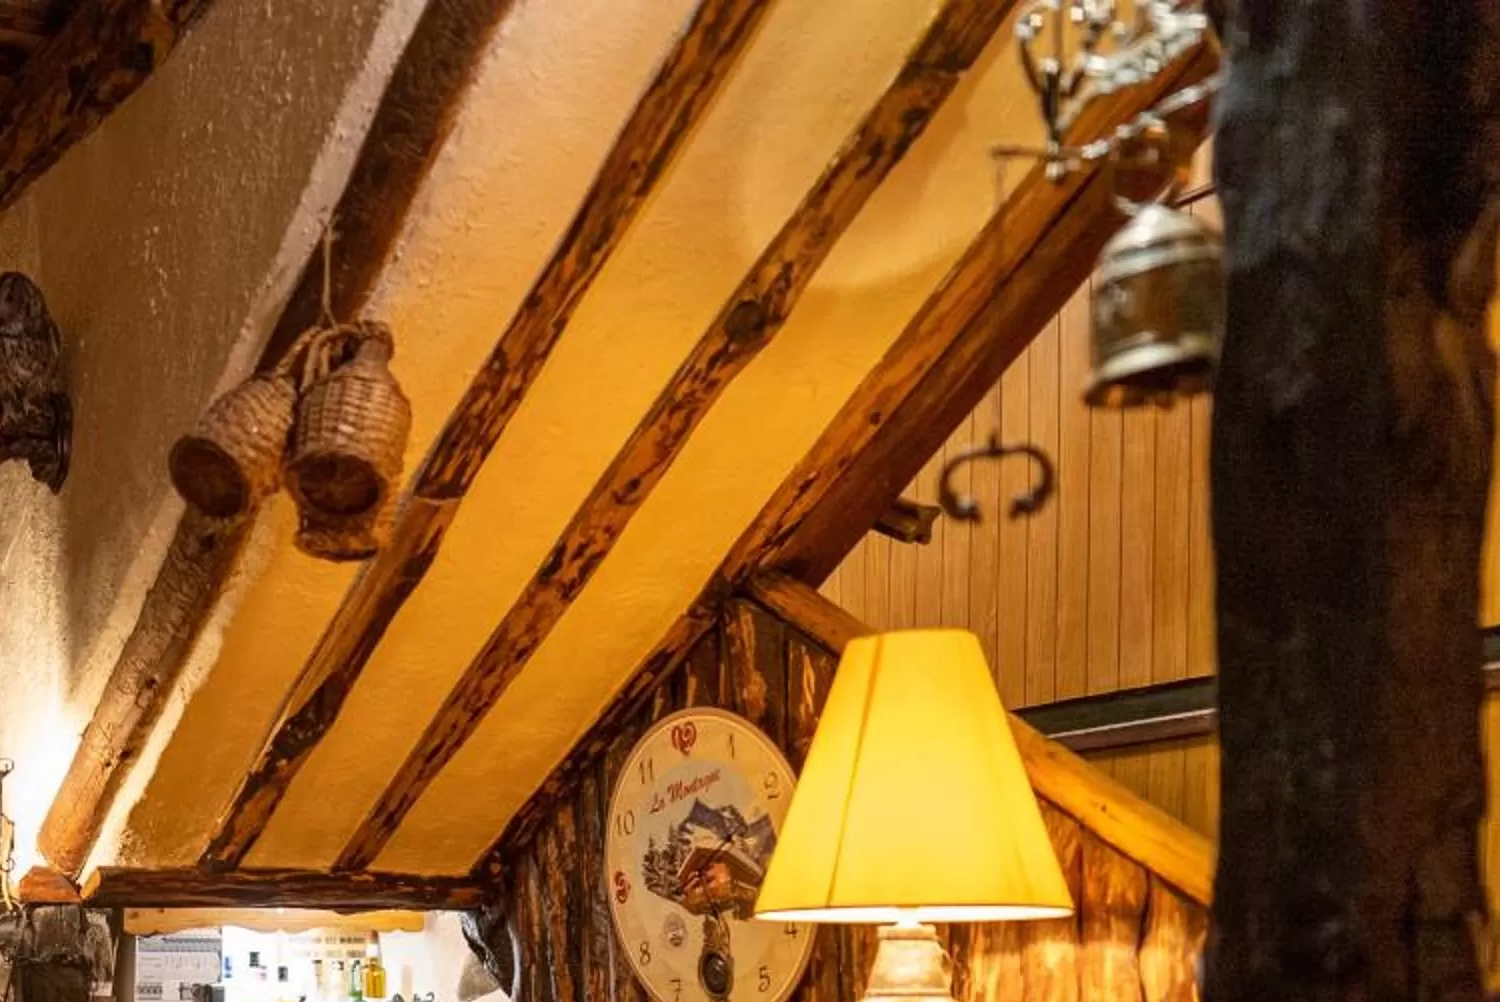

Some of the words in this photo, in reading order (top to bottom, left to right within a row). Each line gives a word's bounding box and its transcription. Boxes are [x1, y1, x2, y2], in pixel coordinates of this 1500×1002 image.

[728, 732, 736, 761] 1
[638, 757, 655, 785] 11
[763, 770, 781, 800] 2
[614, 809, 636, 837] 10
[782, 920, 800, 940] 4
[638, 940, 652, 967] 8
[757, 965, 772, 994] 5
